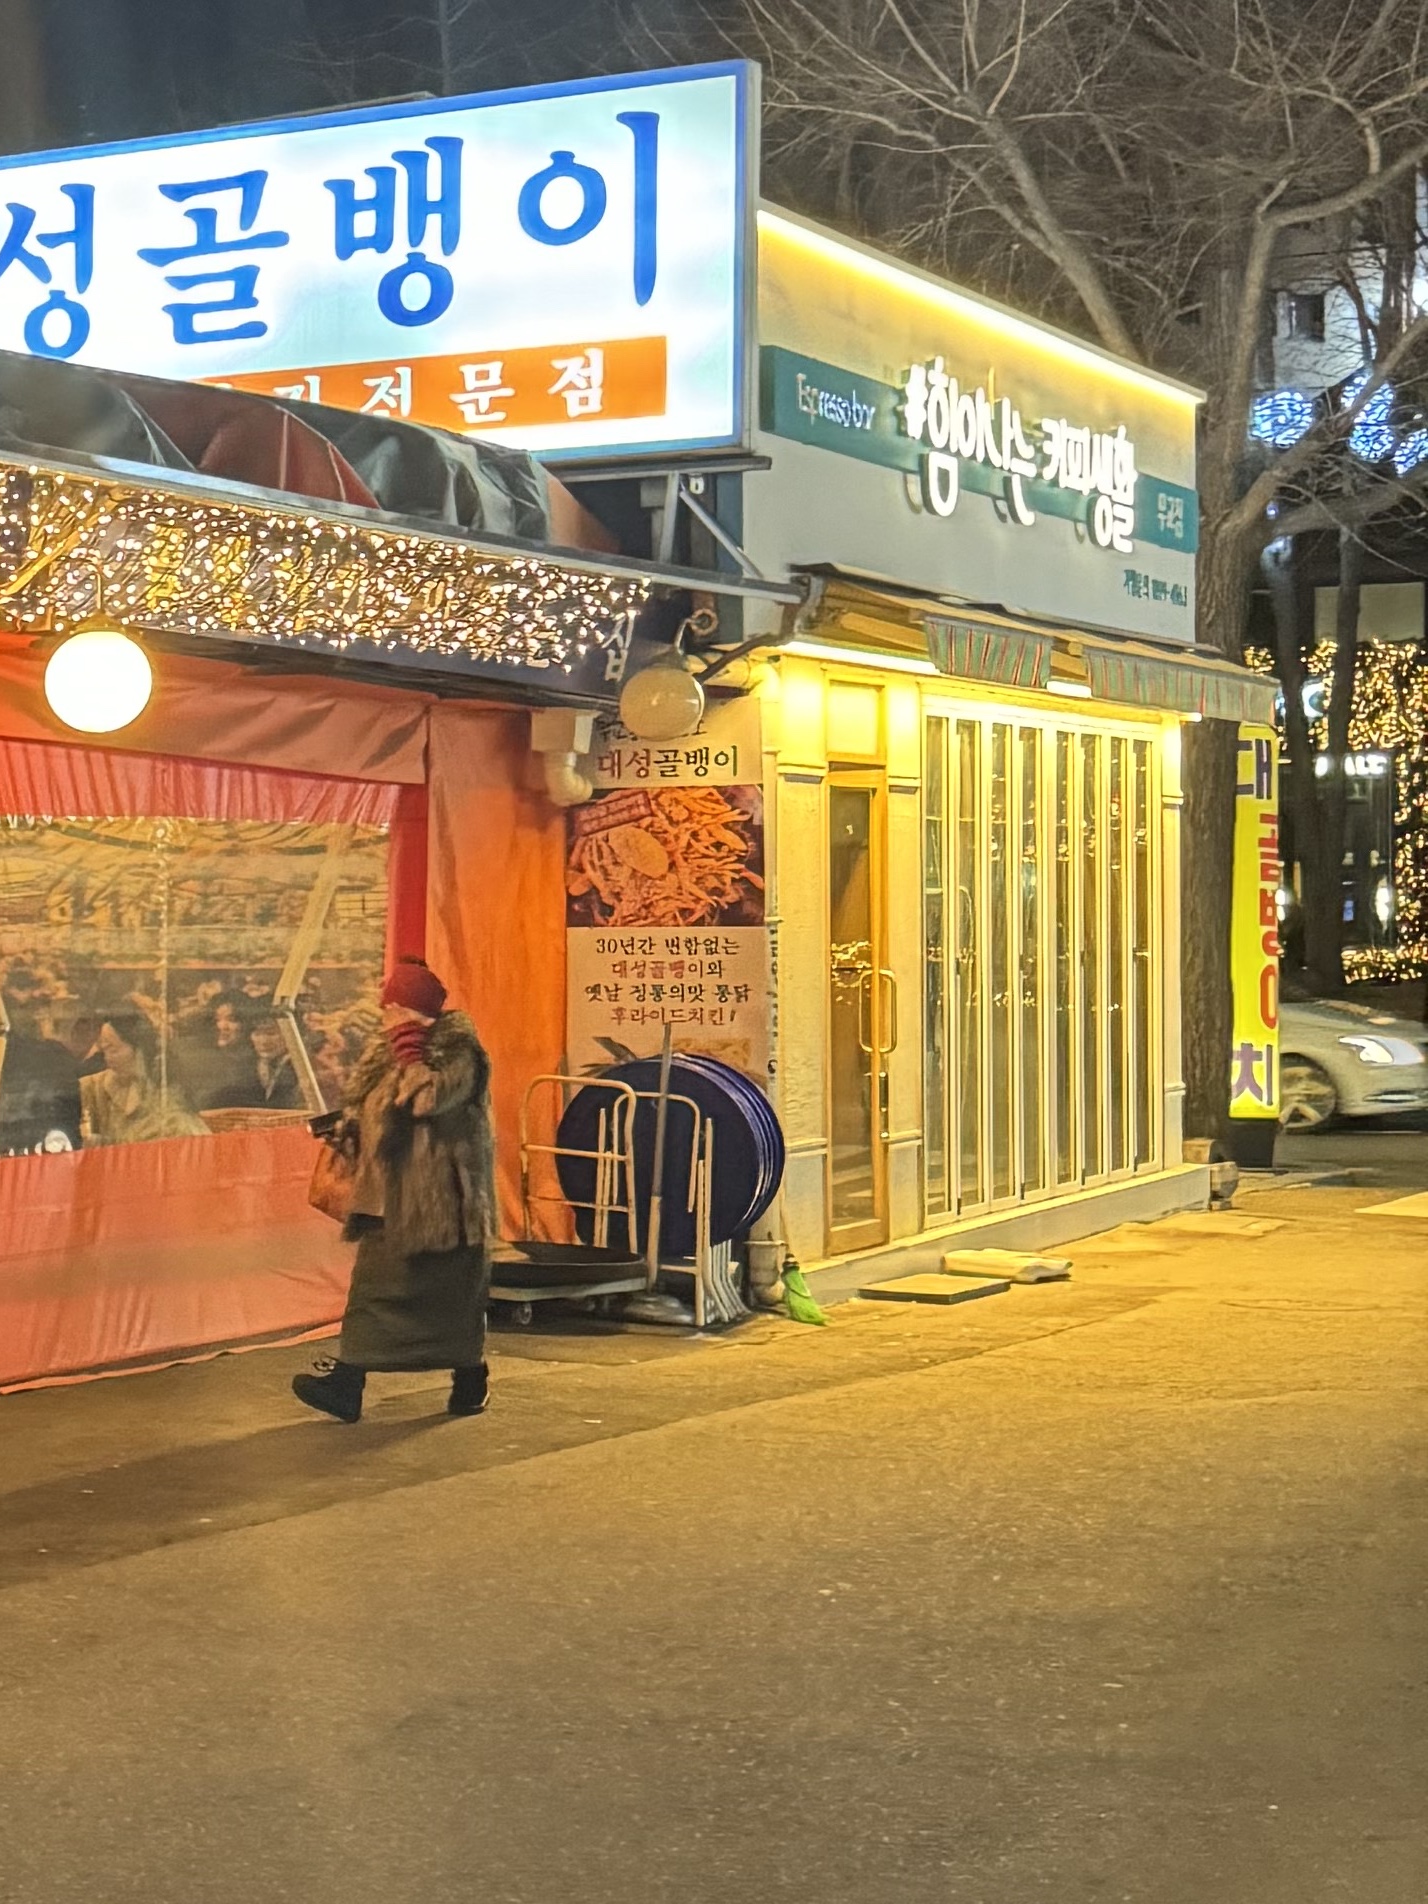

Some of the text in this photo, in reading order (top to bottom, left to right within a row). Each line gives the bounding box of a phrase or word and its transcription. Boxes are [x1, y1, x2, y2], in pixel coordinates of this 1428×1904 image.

[597, 744, 738, 780] 대성골뱅이
[596, 936, 740, 956] 30년간 변함없는
[612, 959, 726, 979] 대성골뱅이와
